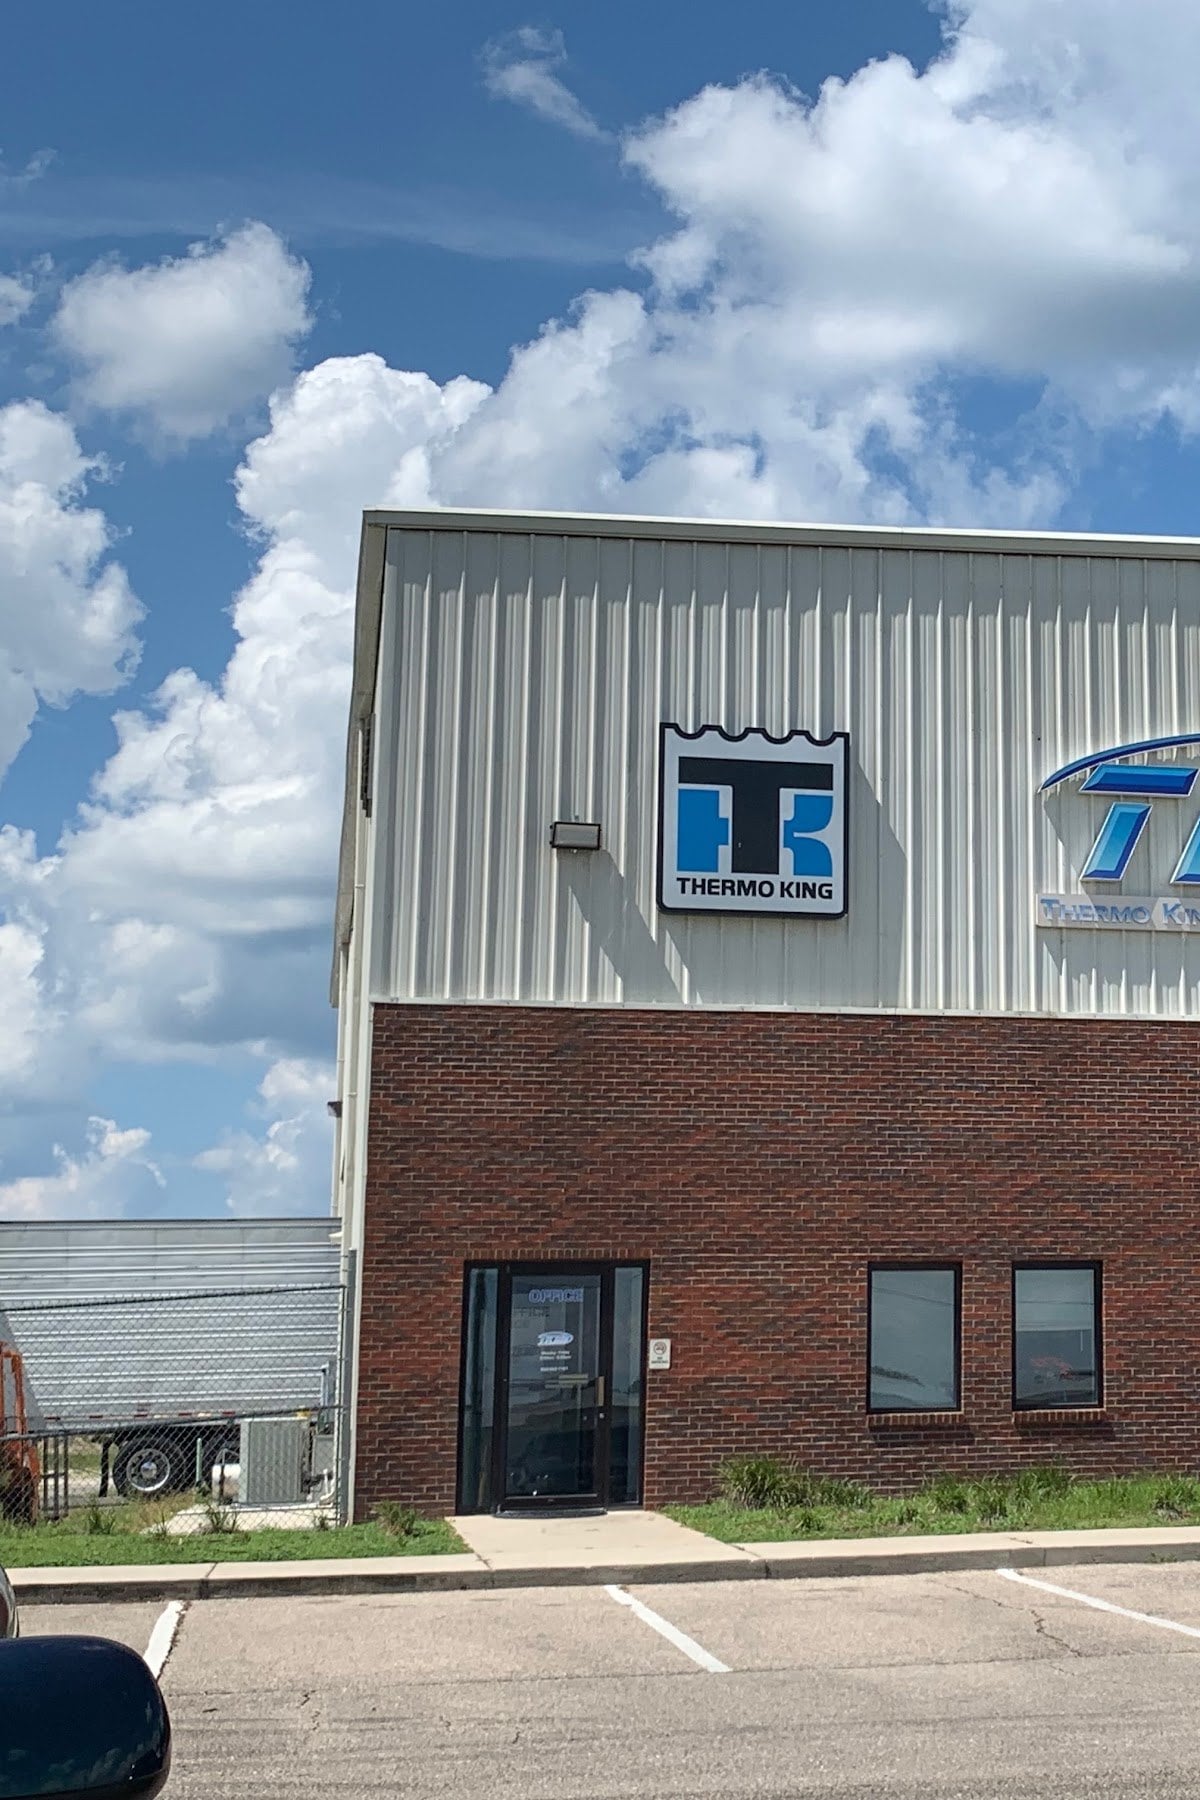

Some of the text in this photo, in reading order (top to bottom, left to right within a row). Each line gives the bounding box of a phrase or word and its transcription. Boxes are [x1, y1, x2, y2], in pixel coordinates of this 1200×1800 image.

[676, 877, 833, 899] THERMO KING
[1041, 898, 1150, 924] THERMO
[529, 1288, 584, 1303] OFFICE
